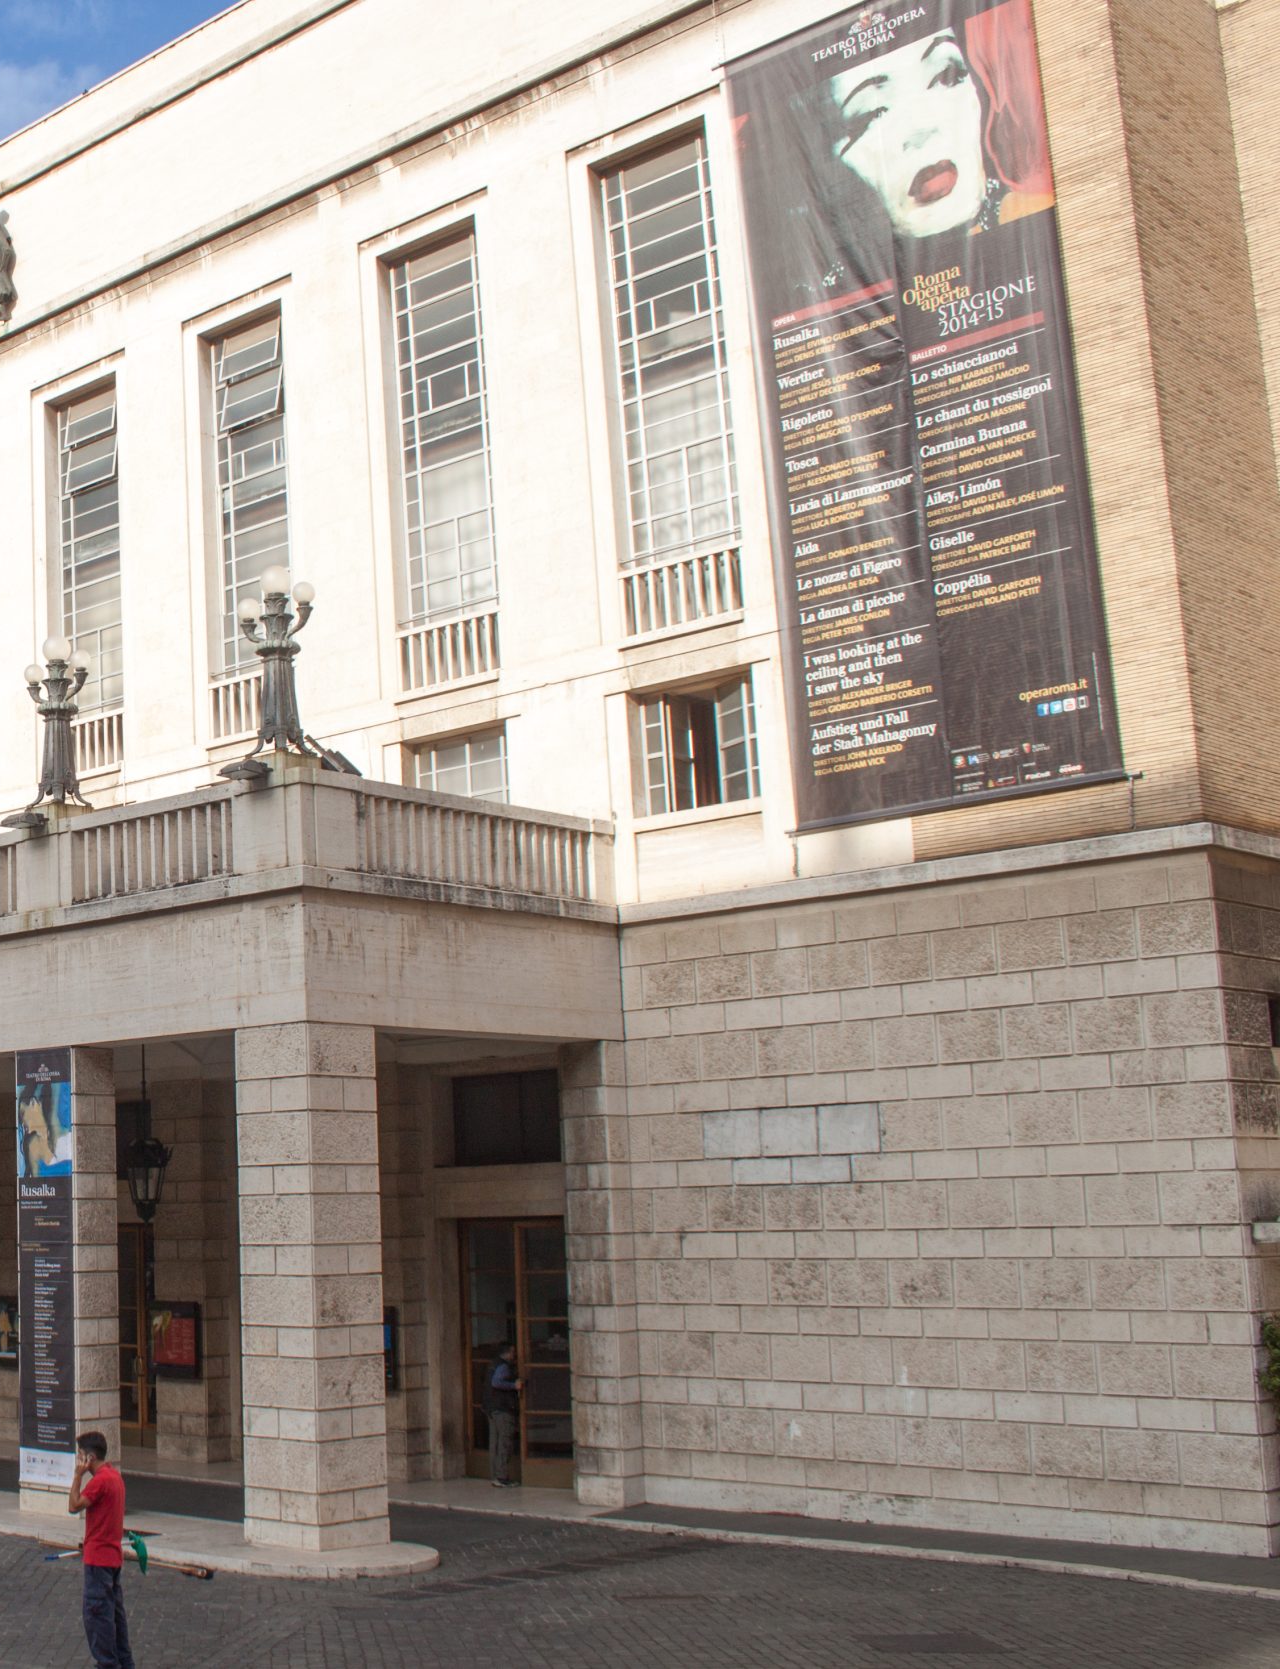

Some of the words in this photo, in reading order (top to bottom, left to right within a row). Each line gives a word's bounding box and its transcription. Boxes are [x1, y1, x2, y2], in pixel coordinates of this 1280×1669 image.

[811, 37, 855, 62] TEATRO
[858, 7, 926, 42] DELL'OPERA
[843, 47, 856, 59] DI
[860, 31, 895, 52] ROMA
[914, 266, 961, 290] Roma
[903, 281, 950, 306] Opera
[921, 286, 970, 312] aperta
[938, 275, 1036, 321] STAGIONE
[939, 302, 1003, 336] 2014-15
[774, 327, 820, 350] Rusalka
[911, 373, 928, 386] Lo
[931, 342, 1019, 379] schiaccianoci
[912, 345, 947, 361] BALLETTO
[777, 368, 825, 390] Werther
[913, 381, 947, 396] DIRETTORE
[948, 375, 962, 385] NIR
[963, 362, 1006, 380] KABARETTI
[914, 387, 959, 405] COREOGRAFIA
[960, 375, 994, 391] AMEDEO
[995, 364, 1029, 380] AMODIO
[916, 416, 933, 429] Le
[935, 404, 971, 423] chant
[973, 399, 990, 412] du
[992, 378, 1052, 407] rossignol
[964, 413, 989, 426] LORCA
[991, 402, 1027, 418] MASSINE
[782, 409, 833, 431] Rigoletto
[815, 417, 850, 432] GAETANO
[851, 404, 894, 422] D'ESPINOSA
[802, 436, 815, 445] LEO
[920, 435, 975, 458] Carmina
[978, 420, 1027, 442] Burana
[922, 454, 957, 469] CREAZIONE
[959, 446, 986, 458] MICHA
[986, 440, 1004, 450] VAN
[1005, 430, 1037, 446] HOECKE
[785, 456, 819, 473] Tosca
[807, 468, 853, 487] ALESSANDRO
[820, 460, 850, 474] DONATO
[923, 469, 957, 483] DIRETTORE
[959, 461, 983, 473] DAVID
[984, 449, 1024, 466] COLEMAN
[790, 499, 820, 516] Lucia
[822, 493, 833, 506] di
[834, 474, 913, 502] Lammermoor
[926, 490, 958, 507] Ailey,
[960, 478, 1002, 498] Limón
[927, 504, 961, 518] DIRETTORE
[963, 496, 988, 508] DAVID
[988, 491, 1005, 501] LEVI
[972, 504, 995, 515] ALVIN
[1037, 485, 1064, 498] LIMÓN
[811, 519, 829, 529] LUCA
[830, 509, 864, 524] RONCONI
[824, 502, 856, 516] ROBERTO
[795, 542, 819, 557] Aida
[828, 545, 858, 560] DONATO
[859, 537, 894, 552] RENZETTI
[930, 531, 975, 550] Giselle
[931, 549, 966, 562] DIRETTORE
[968, 541, 992, 553] DAVID
[993, 529, 1036, 546] GARFORTH
[932, 556, 978, 572] COREOGRAFIA
[979, 546, 1010, 560] PATRICE
[1011, 541, 1032, 552] BART
[797, 579, 812, 591] Le
[814, 570, 848, 587] nozze
[849, 564, 861, 577] di
[863, 558, 902, 574] Figaro
[818, 583, 847, 596] ANDREA
[848, 580, 857, 589] DE
[859, 576, 879, 587] ROSA
[934, 573, 992, 596] Coppélia
[936, 594, 971, 607] DIRETTORE
[973, 587, 997, 598] DAVID
[998, 576, 1042, 592] GARFORTH
[937, 601, 983, 616] COREOGRAFIA
[984, 592, 1018, 606] ROLAND
[1019, 586, 1040, 597] PETIT
[800, 612, 815, 624] La
[817, 605, 850, 620] dama
[852, 599, 864, 612] di
[866, 592, 905, 611] picche
[834, 616, 858, 627] JAMES
[859, 609, 890, 622] CONLON
[821, 629, 842, 639] PETER
[843, 624, 864, 635] STEIN
[804, 656, 810, 667] I
[812, 653, 836, 665] was
[838, 641, 884, 660] looking
[886, 637, 900, 650] at
[901, 633, 922, 646] the
[806, 665, 846, 681] ceiling
[848, 657, 872, 672] and
[874, 653, 903, 667] then
[806, 685, 812, 696] I
[815, 681, 838, 695] saw
[840, 676, 860, 689] the
[863, 672, 884, 685] sky
[842, 685, 885, 700] ALEXANDER
[1019, 678, 1088, 702] operaroma.it
[828, 701, 859, 713] GIORGIO
[898, 685, 933, 699] CORSETTI
[812, 724, 858, 740] Aufstieg
[859, 715, 884, 731] und
[885, 710, 909, 726] Fall
[813, 744, 832, 756] der
[834, 736, 864, 751] Stadt
[865, 724, 937, 745] Mahagonny
[847, 749, 867, 760] JOHN
[868, 744, 903, 757] AXELROD
[833, 760, 867, 772] GRAHAM
[868, 757, 885, 766] VICK
[21, 1184, 55, 1197] Rusalka
